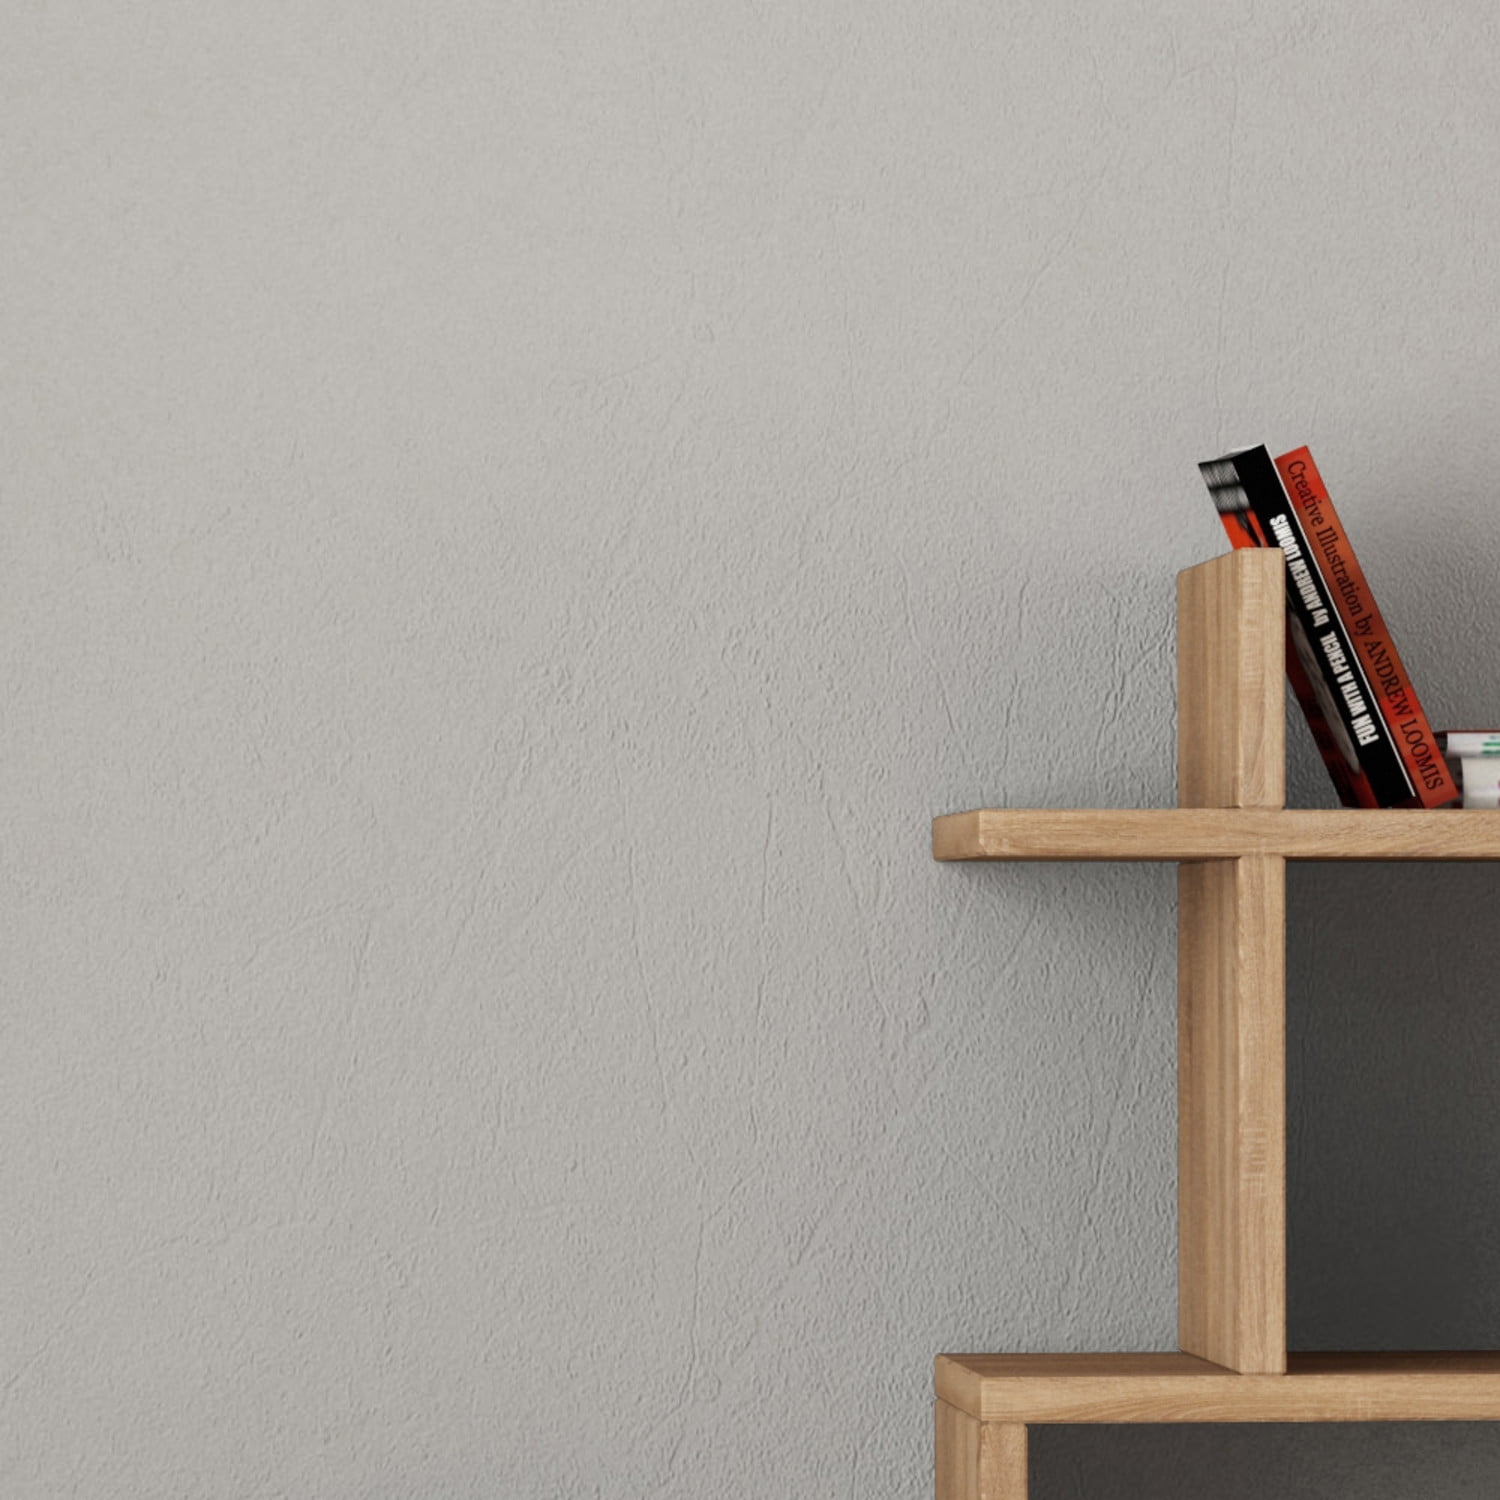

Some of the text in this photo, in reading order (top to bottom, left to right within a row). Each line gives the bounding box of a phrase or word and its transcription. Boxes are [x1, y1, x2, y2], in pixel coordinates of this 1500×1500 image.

[1268, 513, 1379, 746] FUN WITH A PENCIL by ANDREW LOOMIS
[1288, 459, 1444, 791] Creative Illustration by ANDREW LOOMIS
